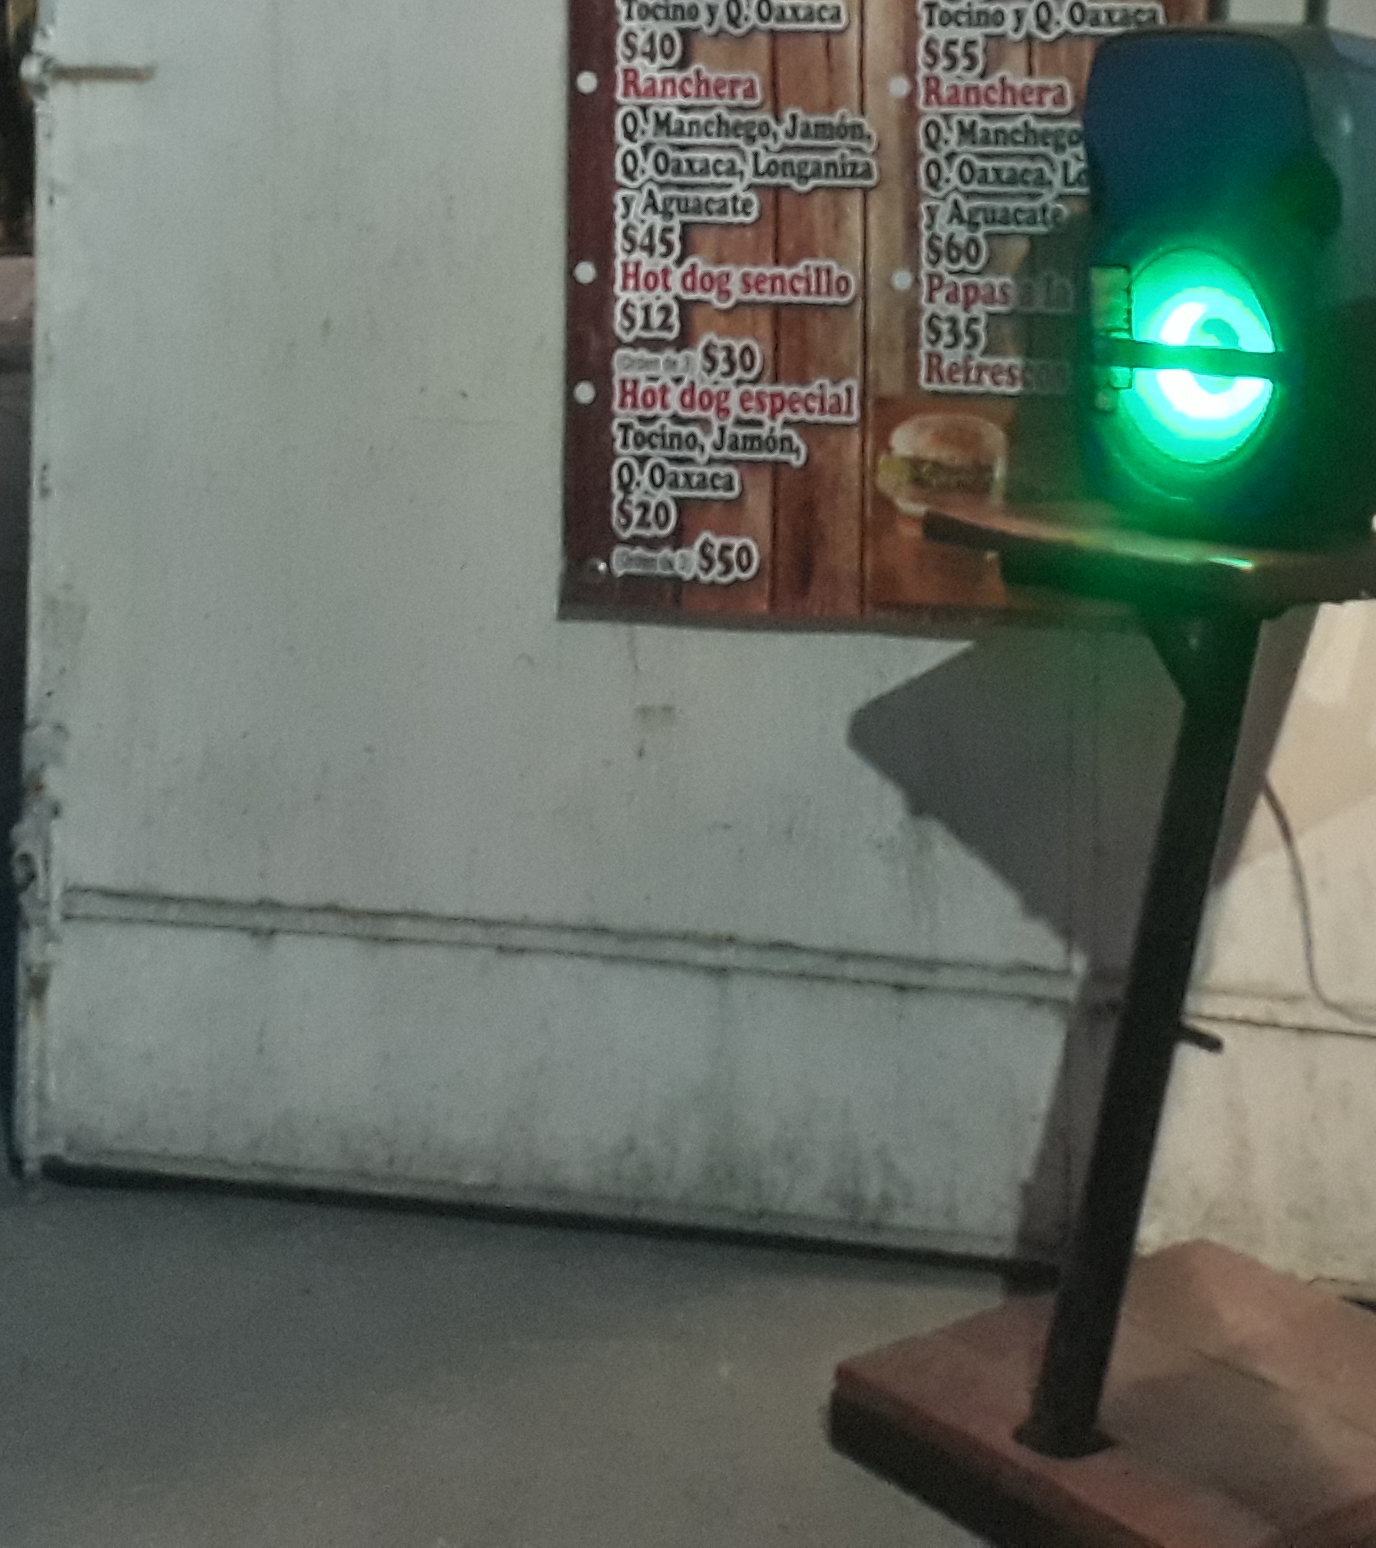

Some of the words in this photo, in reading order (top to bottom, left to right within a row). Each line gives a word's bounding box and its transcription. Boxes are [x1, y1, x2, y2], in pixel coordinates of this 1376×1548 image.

[704, 4, 721, 28] y
[923, 2, 1006, 29] Tocino
[1033, 0, 1061, 35] Q.
[622, 32, 677, 64] $40
[924, 36, 980, 72] $55
[622, 65, 759, 99] Ranchera
[924, 73, 1069, 108] Ranchera
[752, 149, 874, 185] Longaniza
[640, 188, 757, 220] Aguacate
[621, 222, 676, 259] $45
[926, 232, 984, 267] $60
[621, 260, 673, 295] Hot
[680, 263, 731, 301] dog
[739, 266, 852, 298] sencillo
[926, 272, 1014, 312] Papas
[621, 301, 675, 335] $12
[926, 312, 984, 349] $35
[700, 339, 758, 379] $30
[619, 378, 671, 410] Hot
[679, 379, 731, 419] dog
[737, 386, 855, 418] especial
[617, 422, 706, 455] Tocino,
[617, 460, 642, 494] Q.
[648, 462, 735, 492] Oaxaca
[617, 496, 671, 529] $20
[697, 537, 755, 577] $50
